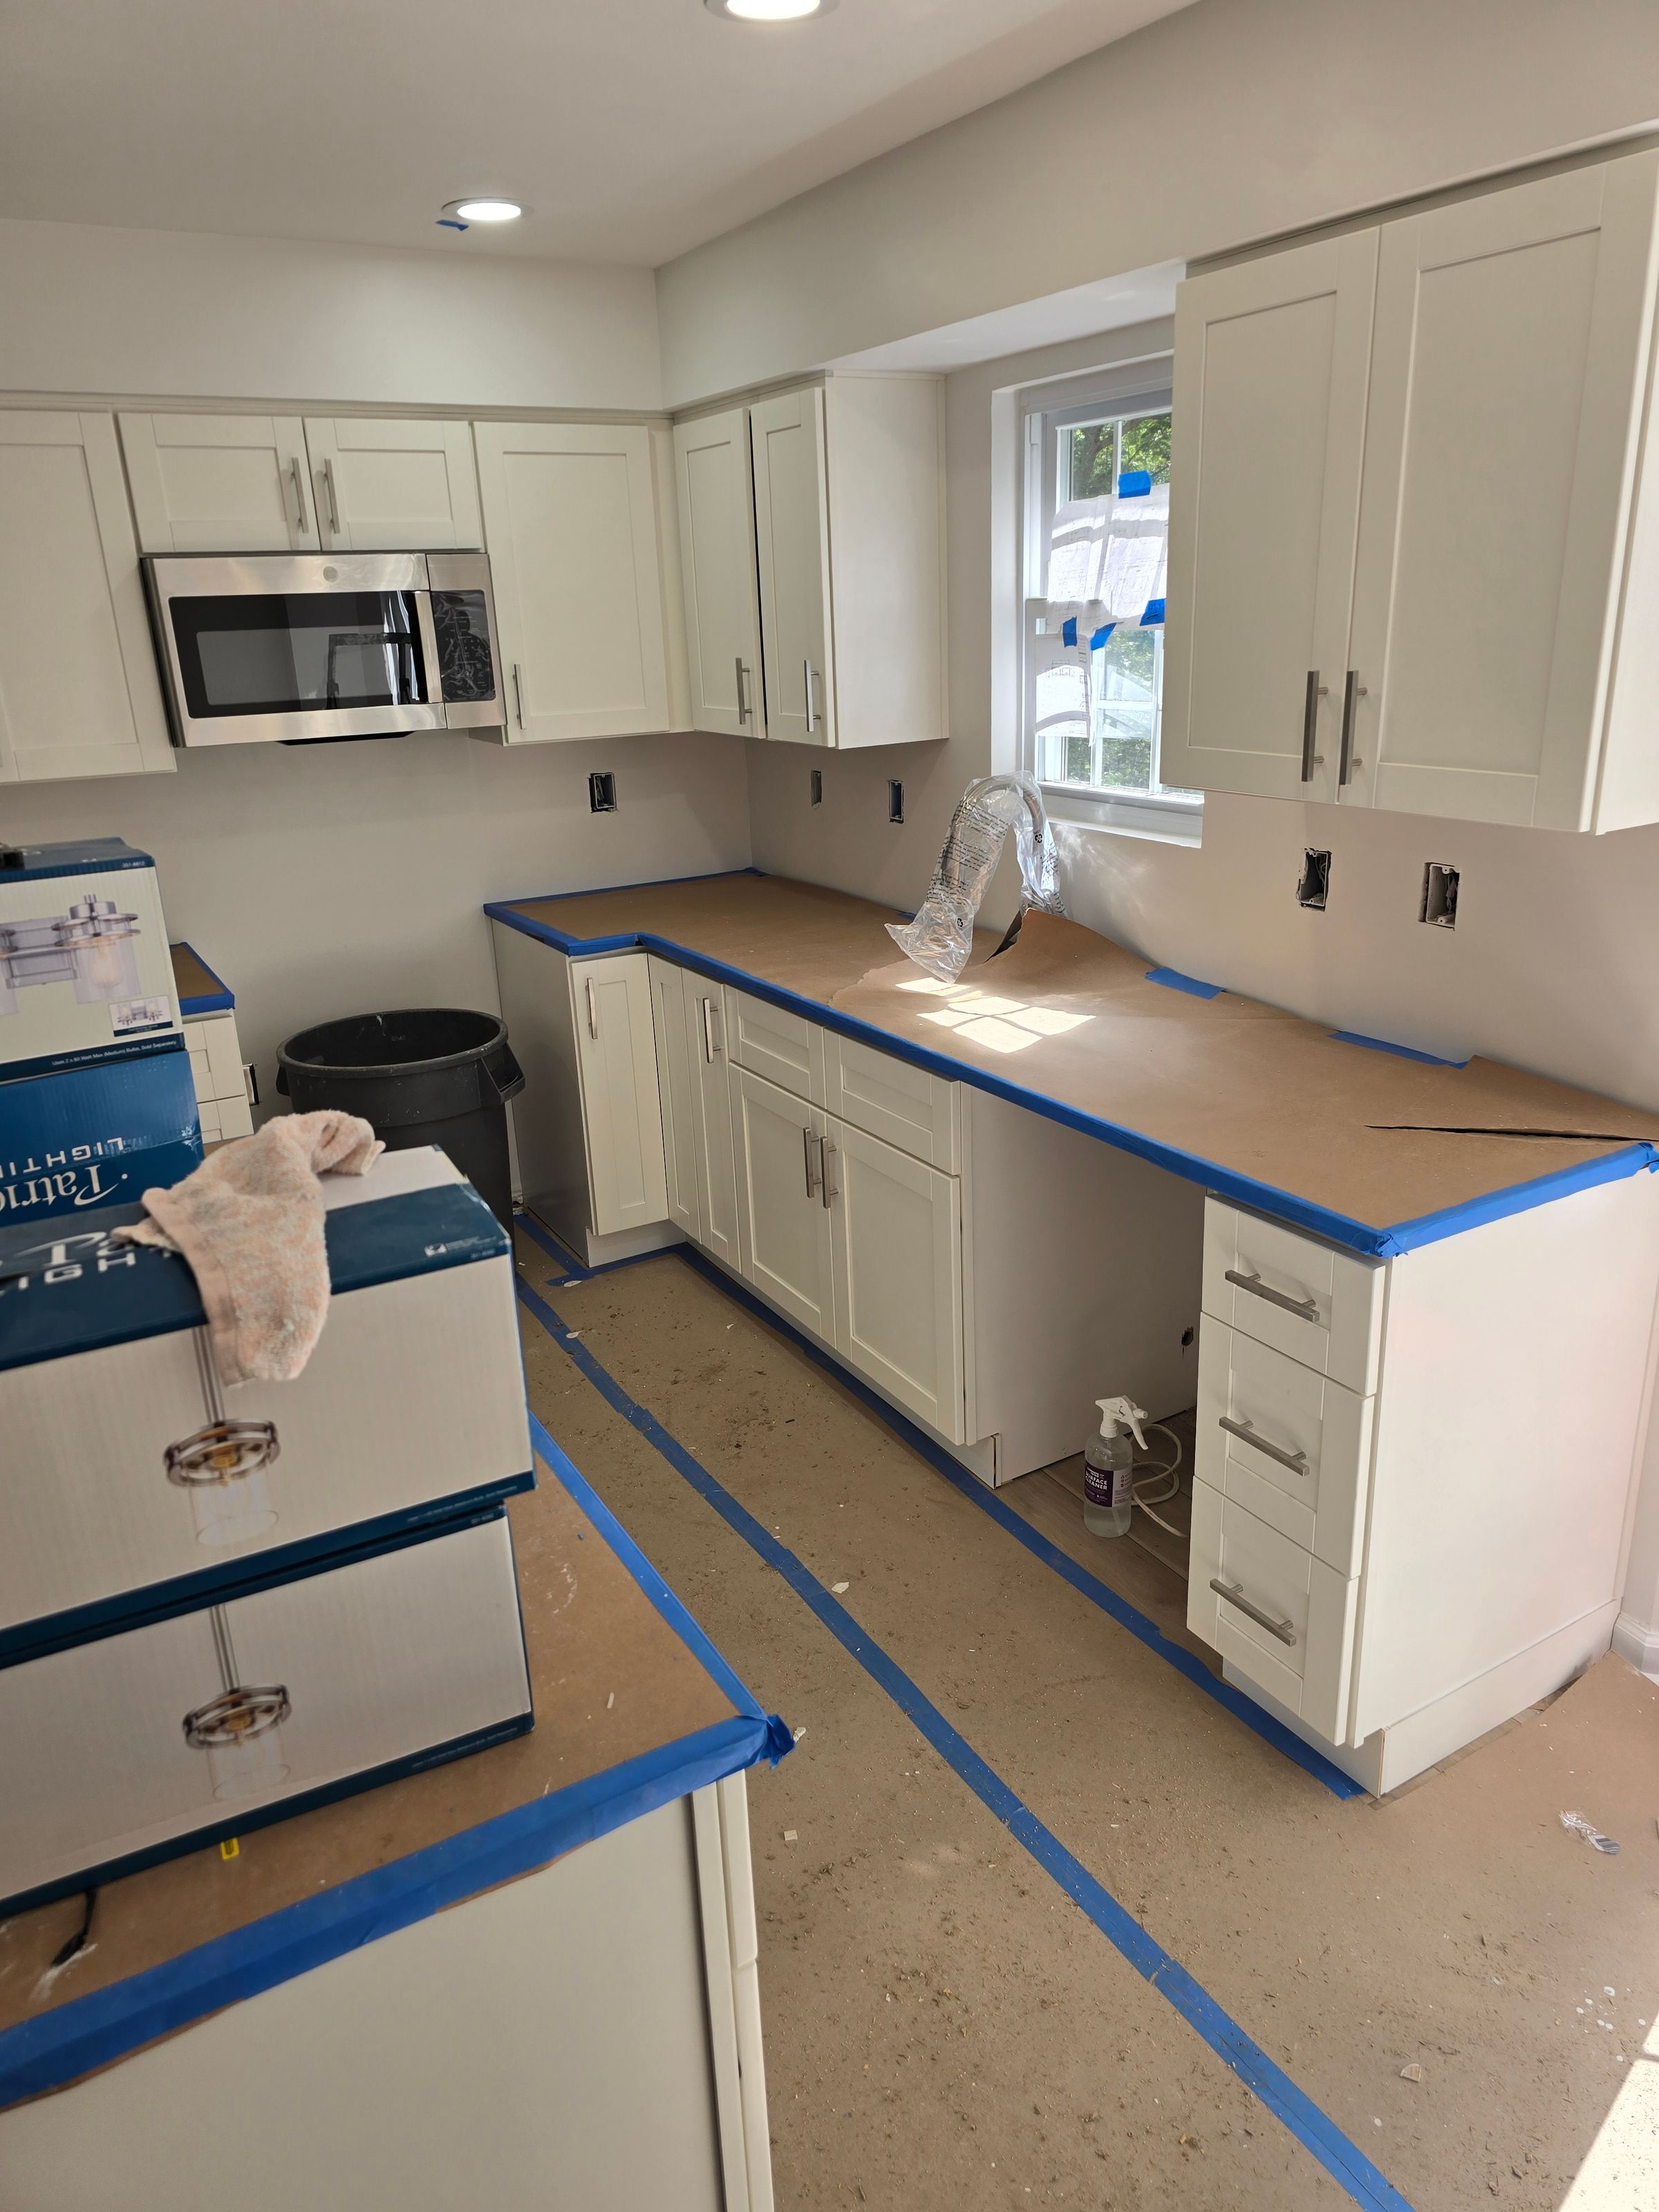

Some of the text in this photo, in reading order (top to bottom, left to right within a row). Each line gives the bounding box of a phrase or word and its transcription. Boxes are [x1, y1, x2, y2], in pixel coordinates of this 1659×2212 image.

[153, 1040, 176, 1049] Separately
[0, 1136, 124, 1178] LIGHTI
[1085, 1471, 1107, 1485] SURFACE
[1085, 1476, 1107, 1490] CLEANER
